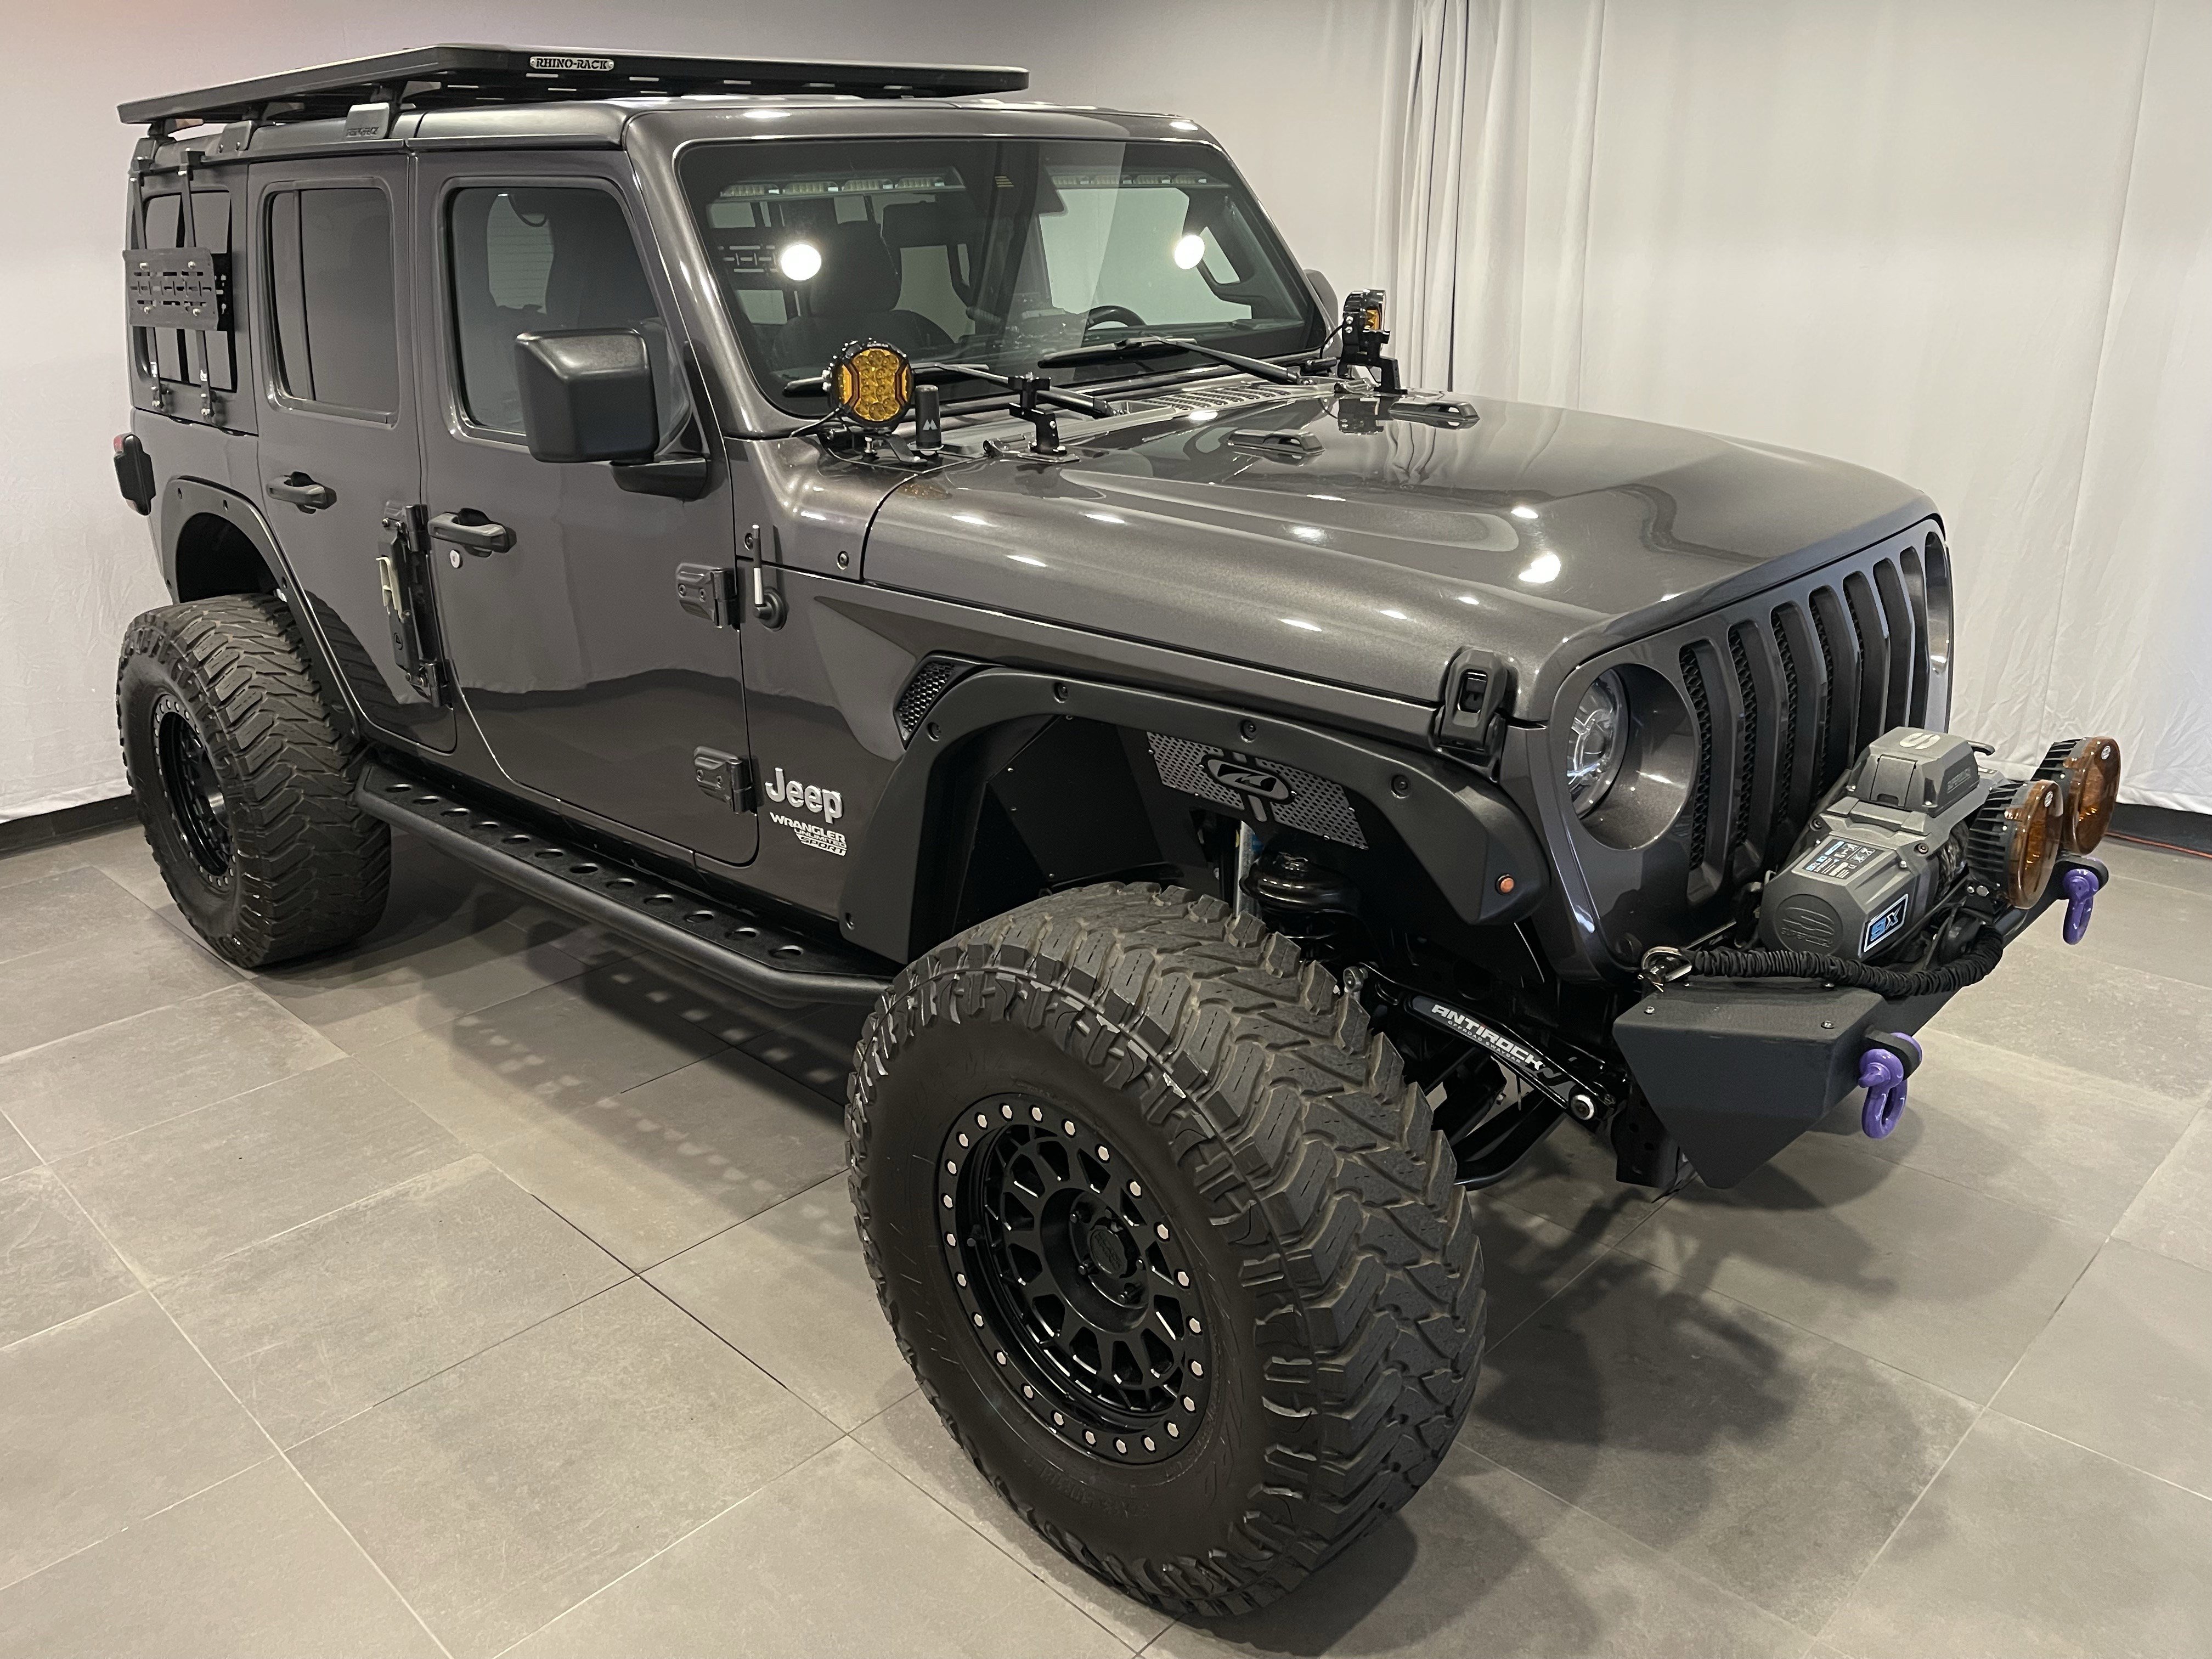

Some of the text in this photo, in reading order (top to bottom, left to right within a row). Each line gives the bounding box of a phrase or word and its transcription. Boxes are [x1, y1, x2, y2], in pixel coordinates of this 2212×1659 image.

[536, 58, 607, 69] RHINO-RACK
[765, 767, 843, 824] Jeep
[770, 812, 845, 842] WRANGLER
[794, 828, 847, 848] UNLIMITED
[800, 837, 844, 854] SPORT
[1870, 905, 1902, 942] SX
[1431, 1004, 1544, 1070] ANTIROCK
[1448, 1020, 1521, 1064] OFFROAD SWAYBAR
